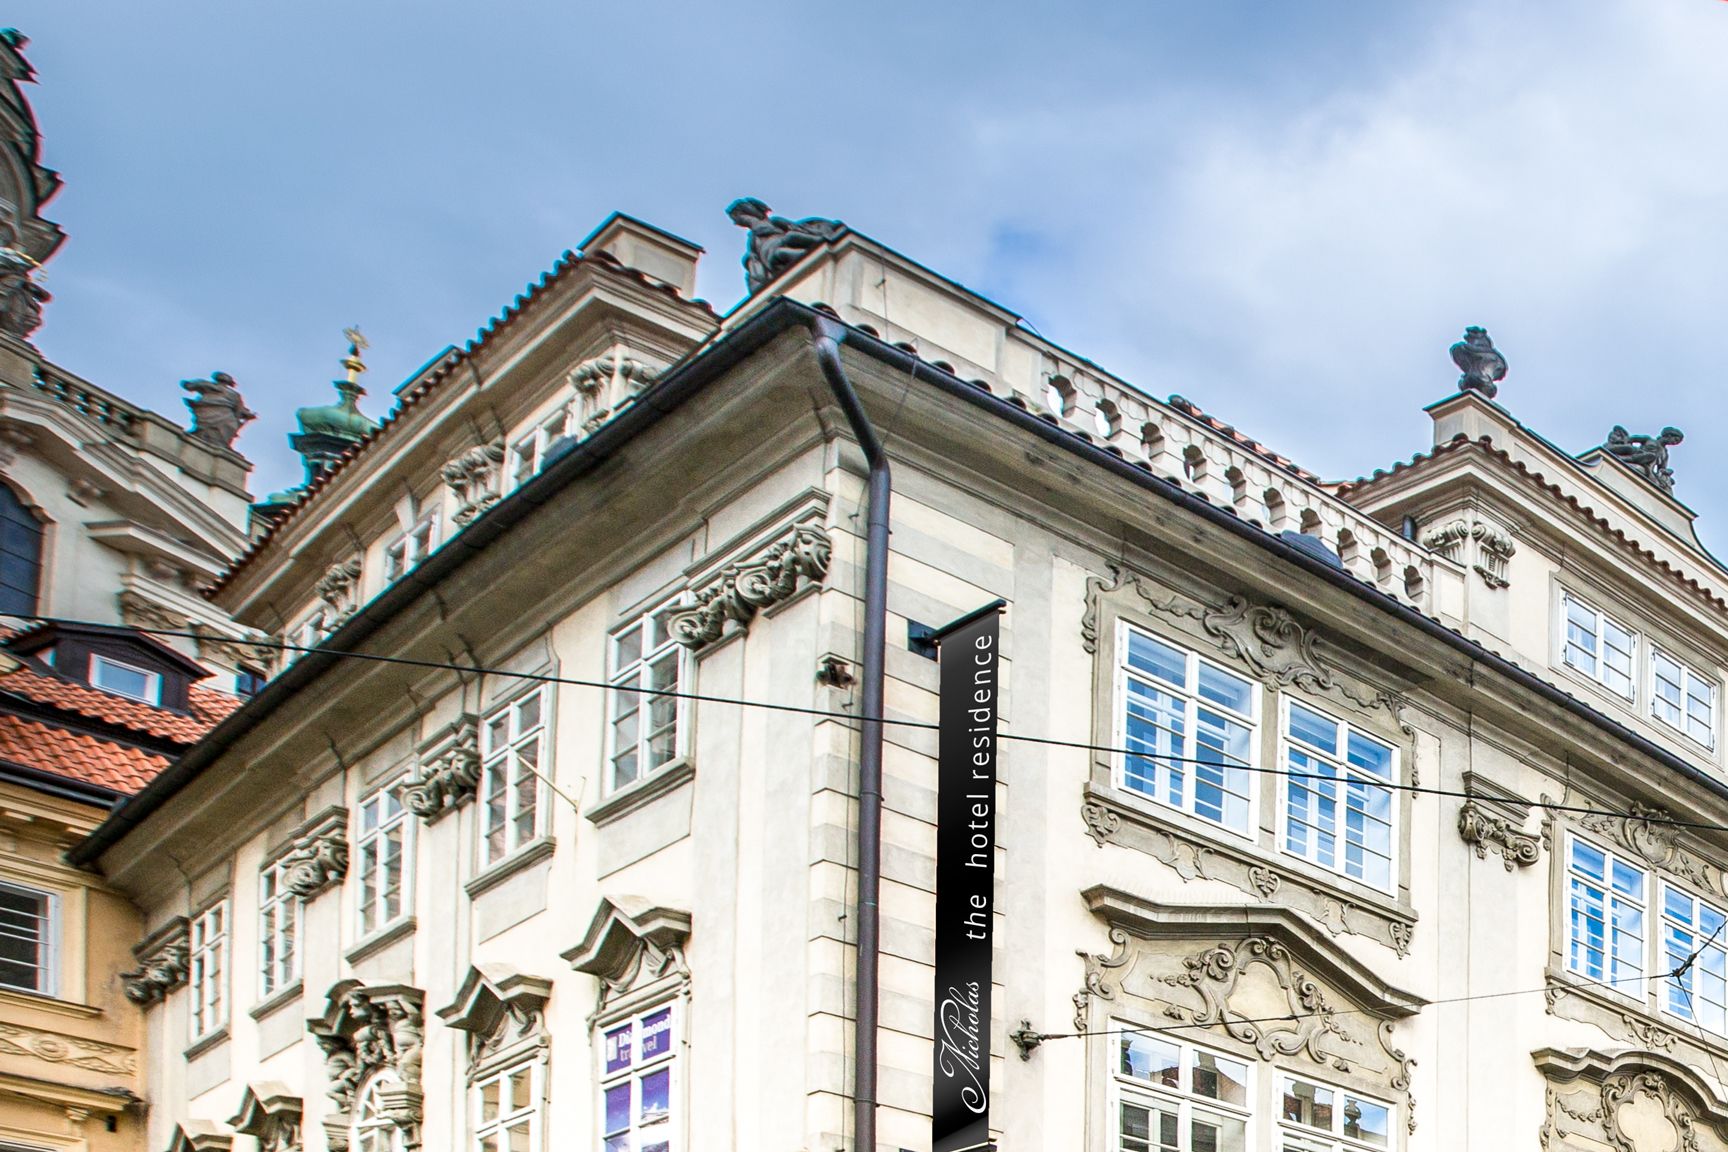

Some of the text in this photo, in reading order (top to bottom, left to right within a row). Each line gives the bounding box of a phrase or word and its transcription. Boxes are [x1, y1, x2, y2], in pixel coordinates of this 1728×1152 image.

[964, 634, 993, 940] the hotel residence
[618, 1014, 671, 1048] Dimond
[939, 981, 987, 1114] Nicholas
